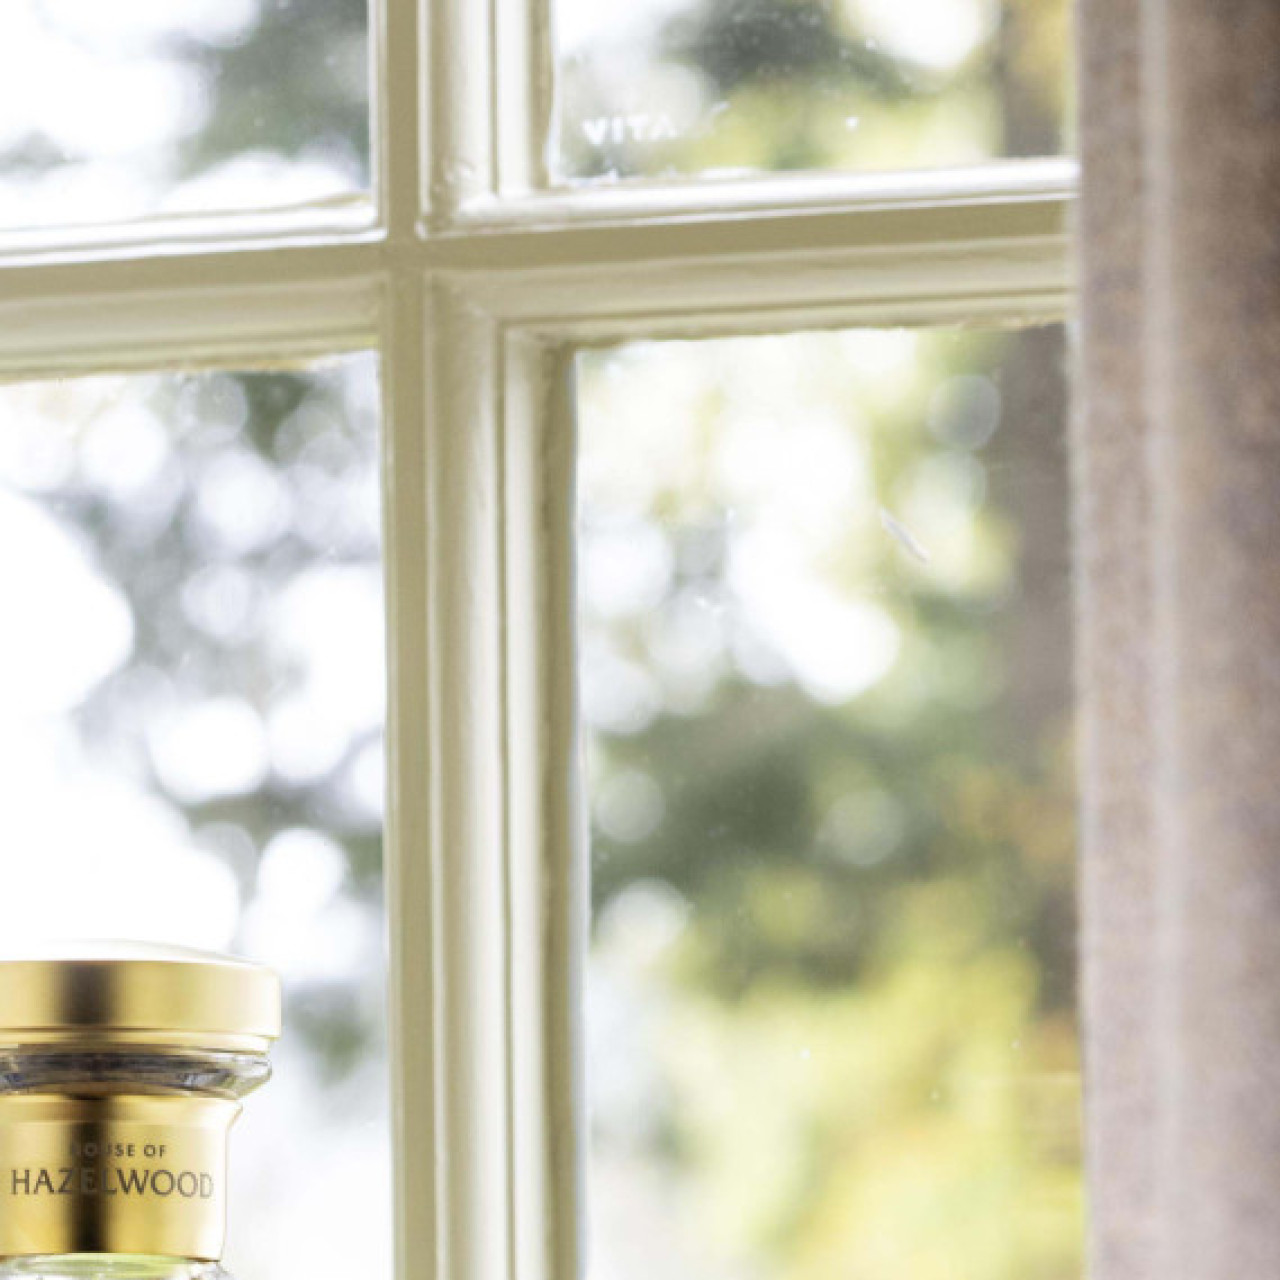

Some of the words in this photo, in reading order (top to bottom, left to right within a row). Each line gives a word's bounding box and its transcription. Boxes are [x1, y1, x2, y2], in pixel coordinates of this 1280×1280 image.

[70, 1143, 134, 1157] OUSE
[144, 1144, 166, 1158] OF
[11, 1168, 214, 1198] HAZELWOOD
